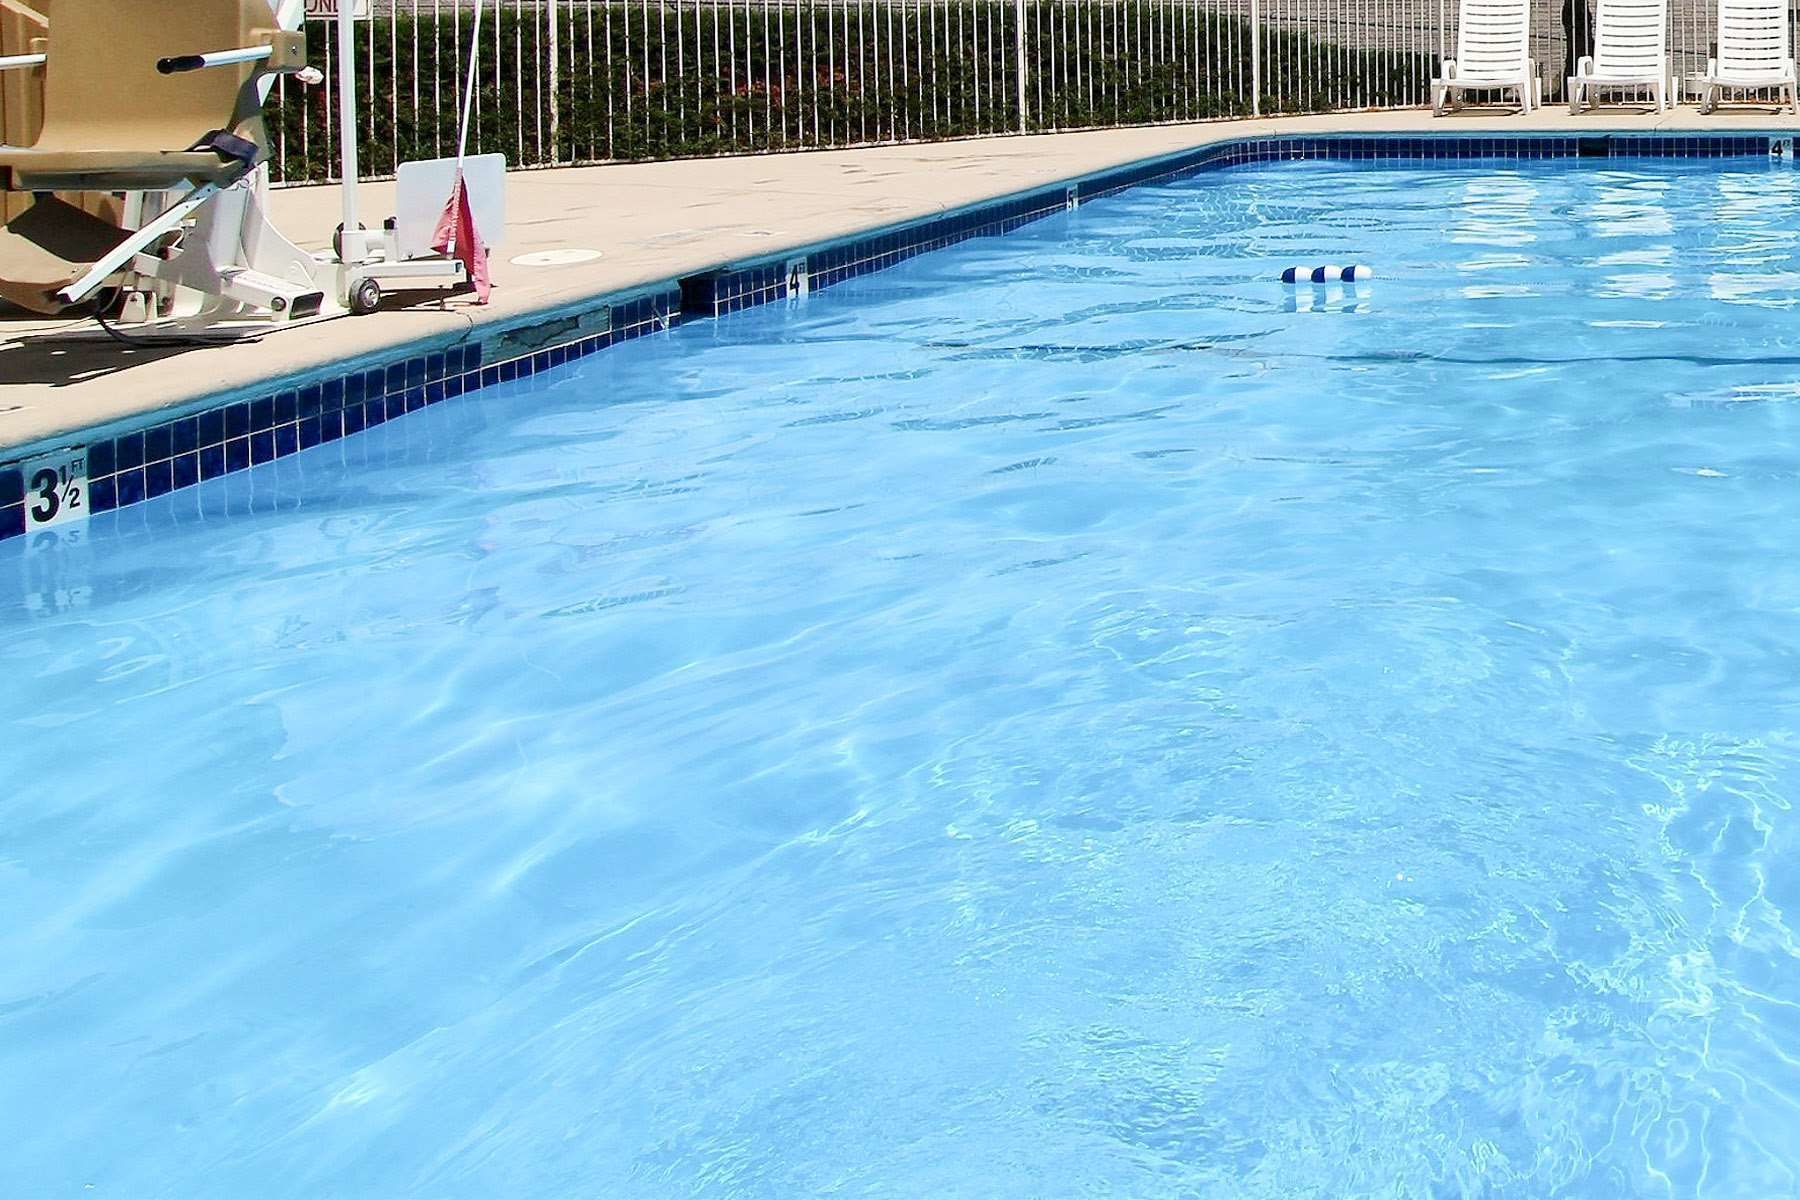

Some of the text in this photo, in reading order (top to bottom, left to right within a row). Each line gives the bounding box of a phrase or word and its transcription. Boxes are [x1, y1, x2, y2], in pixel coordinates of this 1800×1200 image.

[1771, 140, 1783, 156] 4
[790, 264, 800, 298] 4
[71, 457, 85, 475] FT
